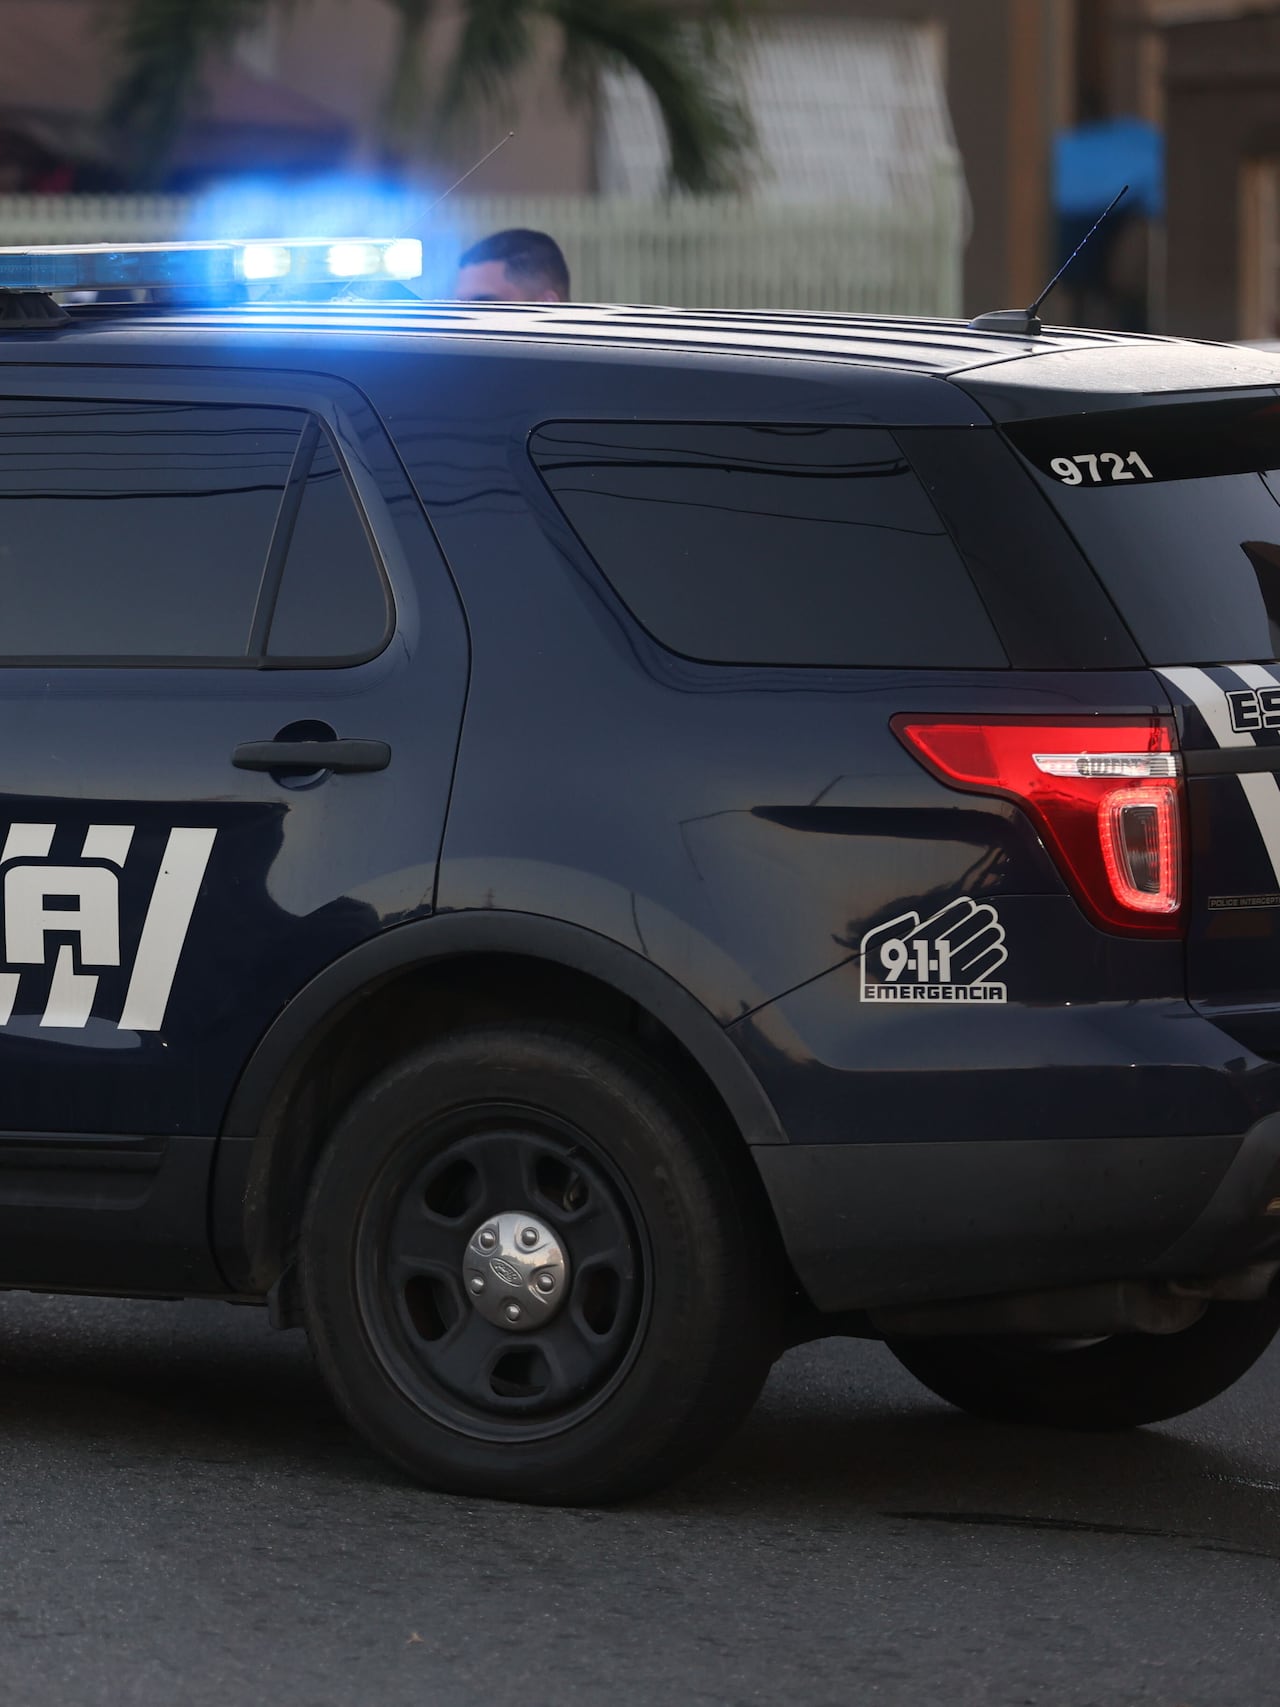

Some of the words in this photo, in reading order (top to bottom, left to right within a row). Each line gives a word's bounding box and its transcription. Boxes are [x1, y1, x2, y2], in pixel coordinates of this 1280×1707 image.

[1050, 451, 1154, 485] 9721
[1241, 897, 1280, 906] INTERCEPT
[864, 986, 1003, 1000] EMERGENCIA
